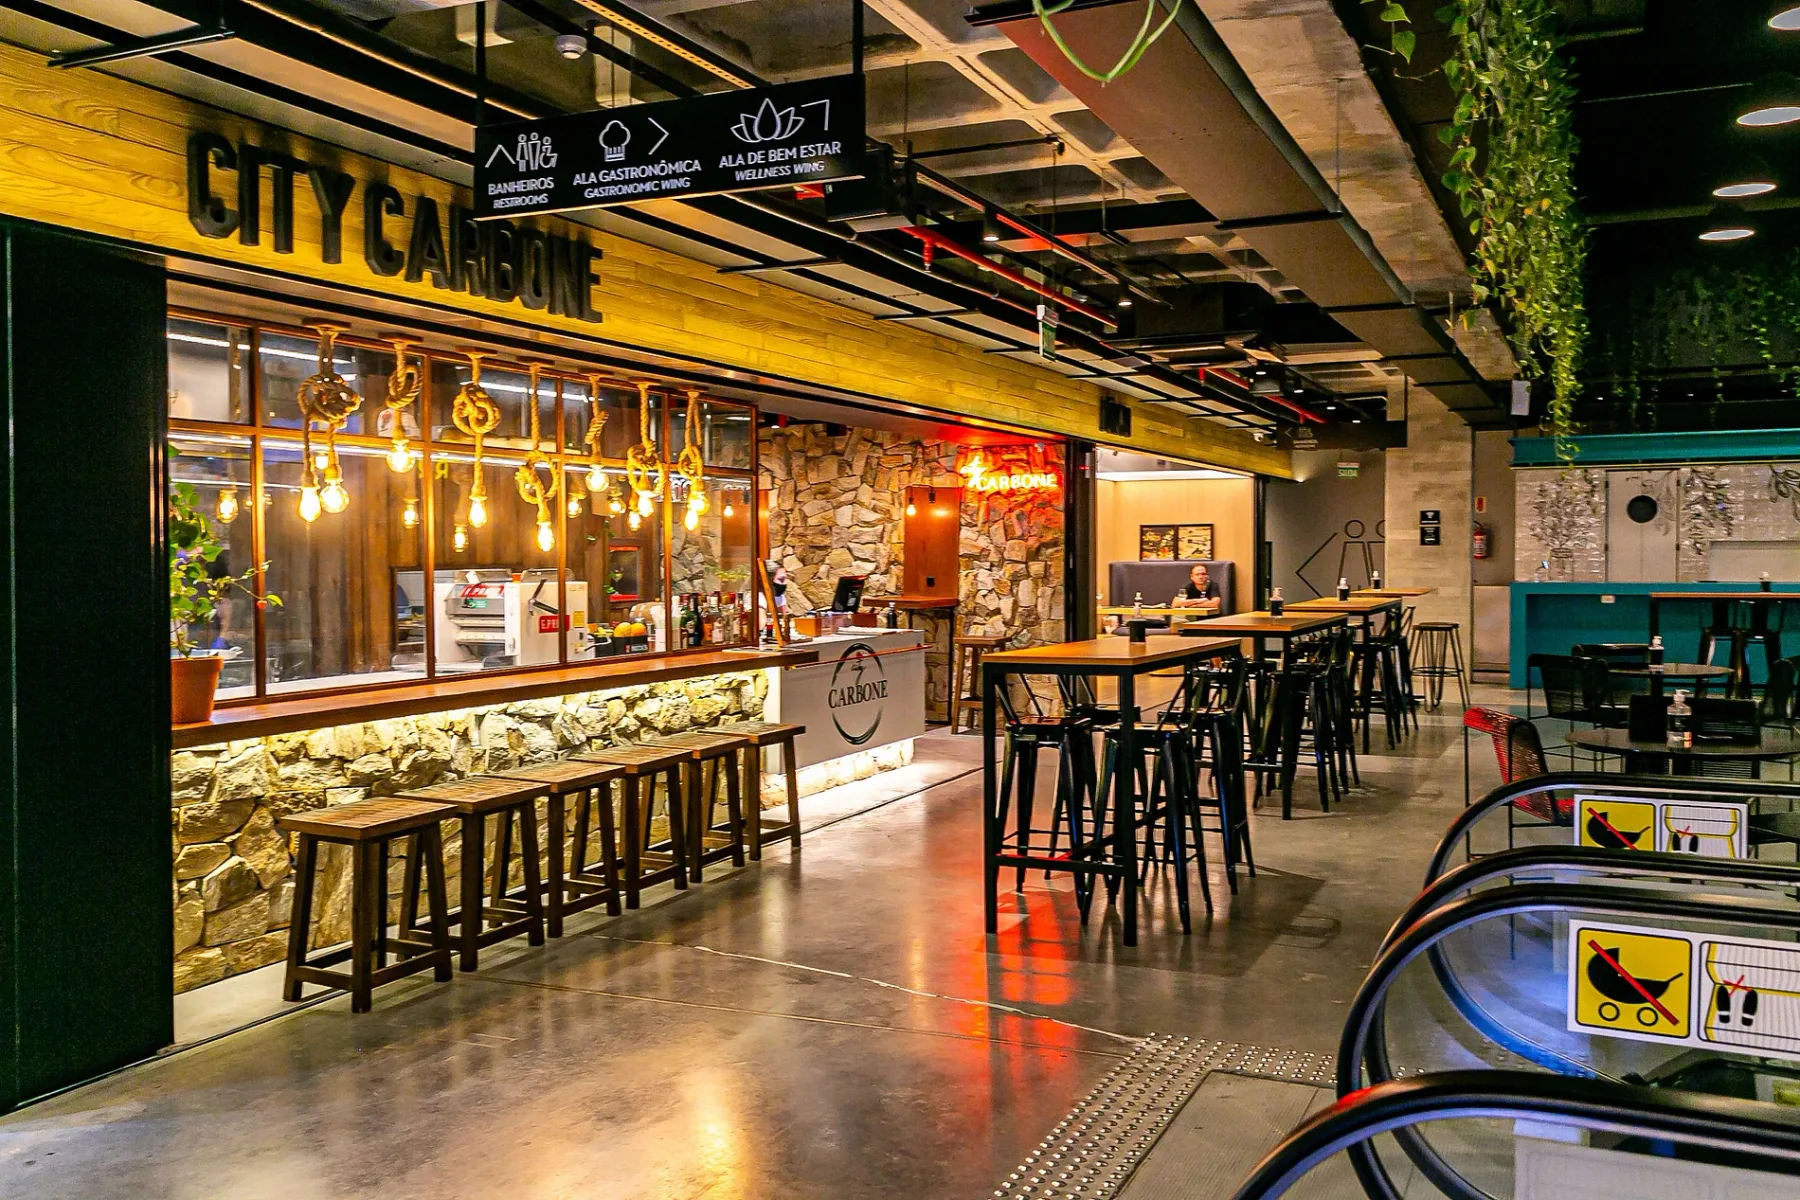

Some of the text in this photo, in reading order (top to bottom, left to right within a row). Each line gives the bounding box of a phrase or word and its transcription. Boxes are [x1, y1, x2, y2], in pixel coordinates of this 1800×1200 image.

[718, 141, 841, 168] ALA DE BEM ESTAR
[572, 160, 702, 185] ALA GASTRONÔMICA
[735, 161, 825, 181] WELLNESS WING
[488, 177, 554, 195] BANHEIROS
[583, 177, 691, 198] GASTRONOMIC WING
[493, 193, 549, 209] RESTROOMS
[187, 131, 604, 324] CITY CARBONE
[977, 473, 1057, 491] CARBONE
[828, 679, 888, 709] CARBONE
